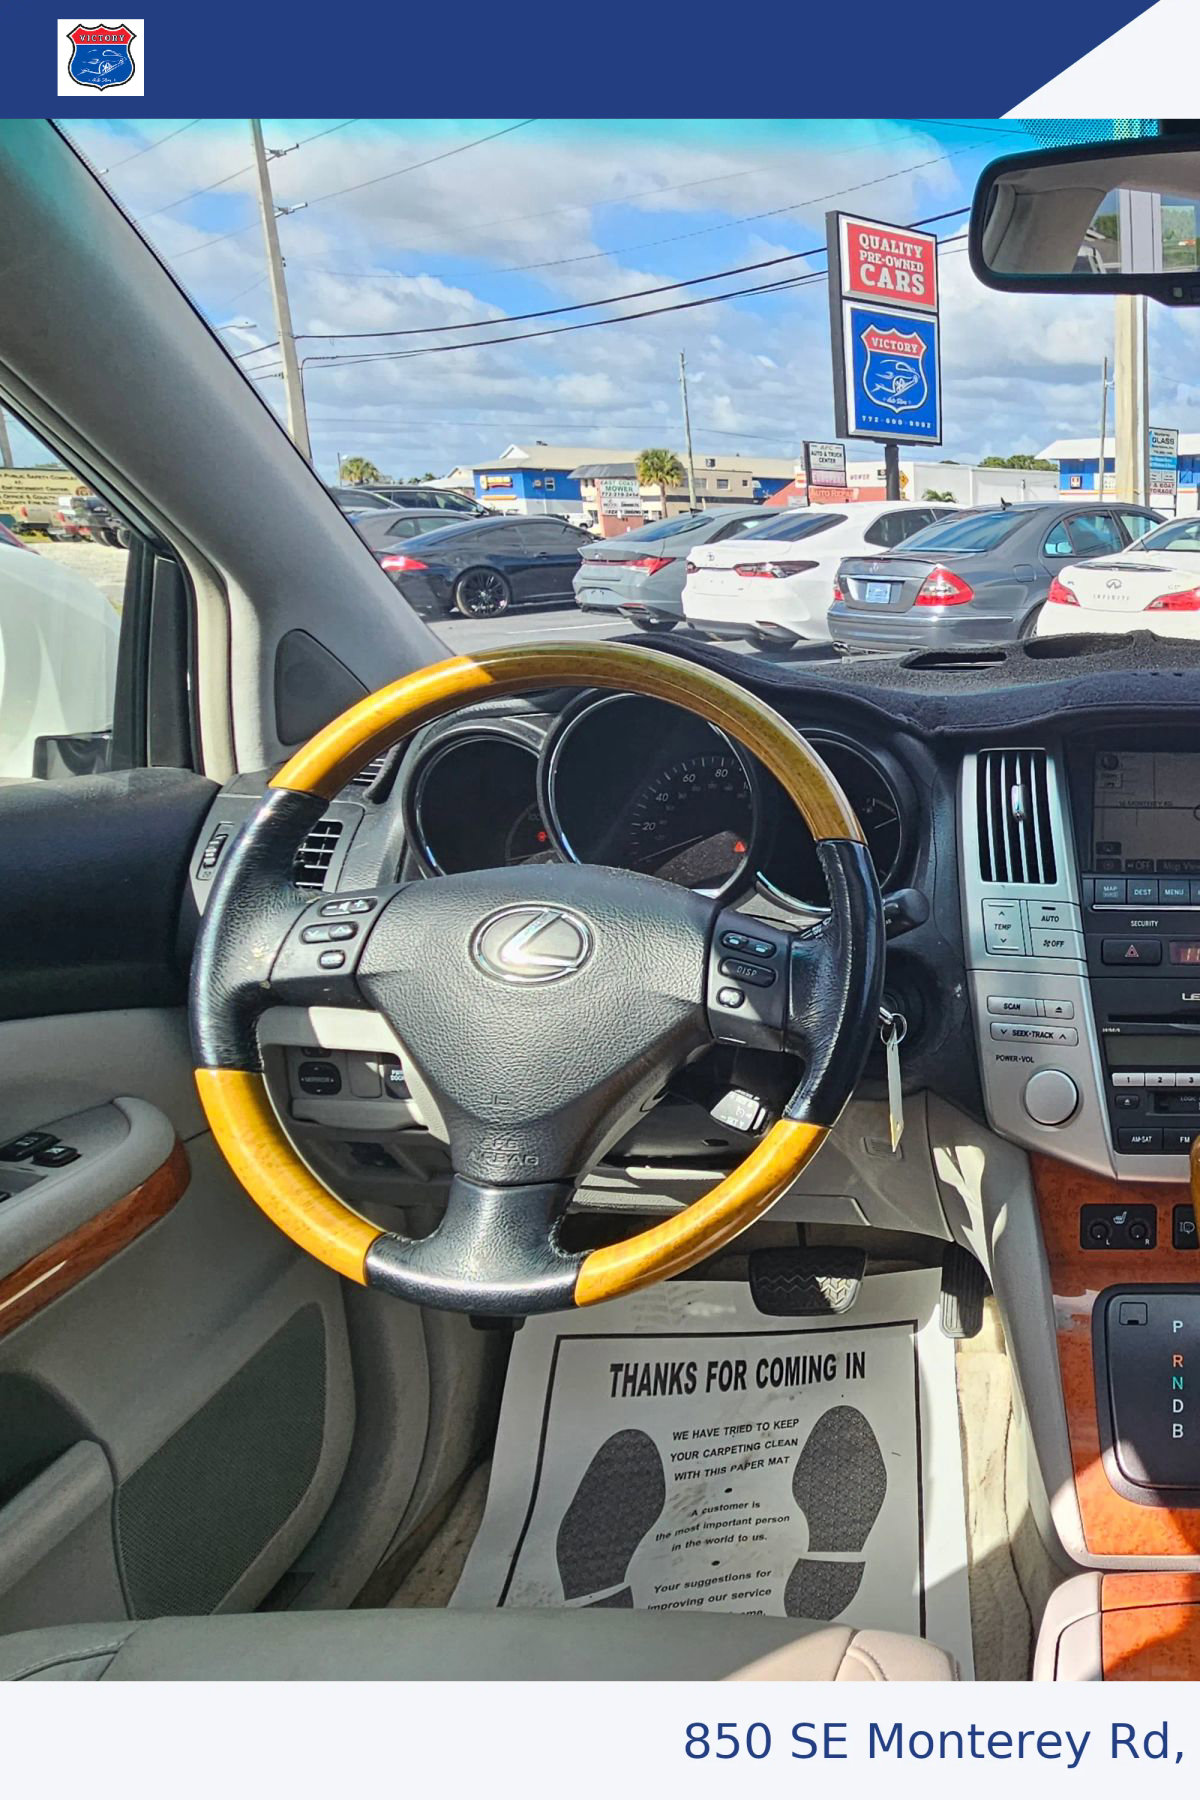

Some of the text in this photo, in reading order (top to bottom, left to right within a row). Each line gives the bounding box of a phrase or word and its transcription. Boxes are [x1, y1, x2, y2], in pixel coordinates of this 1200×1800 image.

[859, 233, 923, 259] QUALITY
[859, 250, 924, 273] PRE-OWNED
[860, 263, 925, 295] CARS
[871, 337, 919, 353] VICTORY
[1152, 437, 1175, 446] GLASS
[682, 773, 696, 783] 60
[714, 769, 728, 778] 80
[655, 793, 669, 802] 40
[642, 822, 656, 831] 20
[1041, 915, 1060, 923] AUTO
[994, 923, 1012, 931] TEMP
[1051, 940, 1065, 948] OFF
[736, 965, 758, 977] DISP
[1003, 1003, 1021, 1011] SCAN
[1173, 1320, 1184, 1333] P
[1173, 1355, 1184, 1368] R
[609, 1351, 866, 1398] THANKS FOR COMING IN
[1172, 1377, 1184, 1390] N
[1173, 1400, 1184, 1413] D
[672, 1418, 800, 1441] WE HAVE TRIED TO KEEP
[1173, 1424, 1184, 1438] B
[670, 1438, 799, 1462] YOUR CARPETING CLEAN
[674, 1456, 790, 1481] WITH THIS PAPER MAT
[701, 1501, 749, 1514] customer
[655, 1515, 790, 1542] the most important person
[671, 1544, 682, 1552] in
[685, 1540, 702, 1549] the
[704, 1534, 735, 1545] world
[738, 1534, 748, 1542] to
[654, 1569, 772, 1594] Your suggestions for
[707, 1593, 728, 1603] our
[731, 1588, 772, 1600] service
